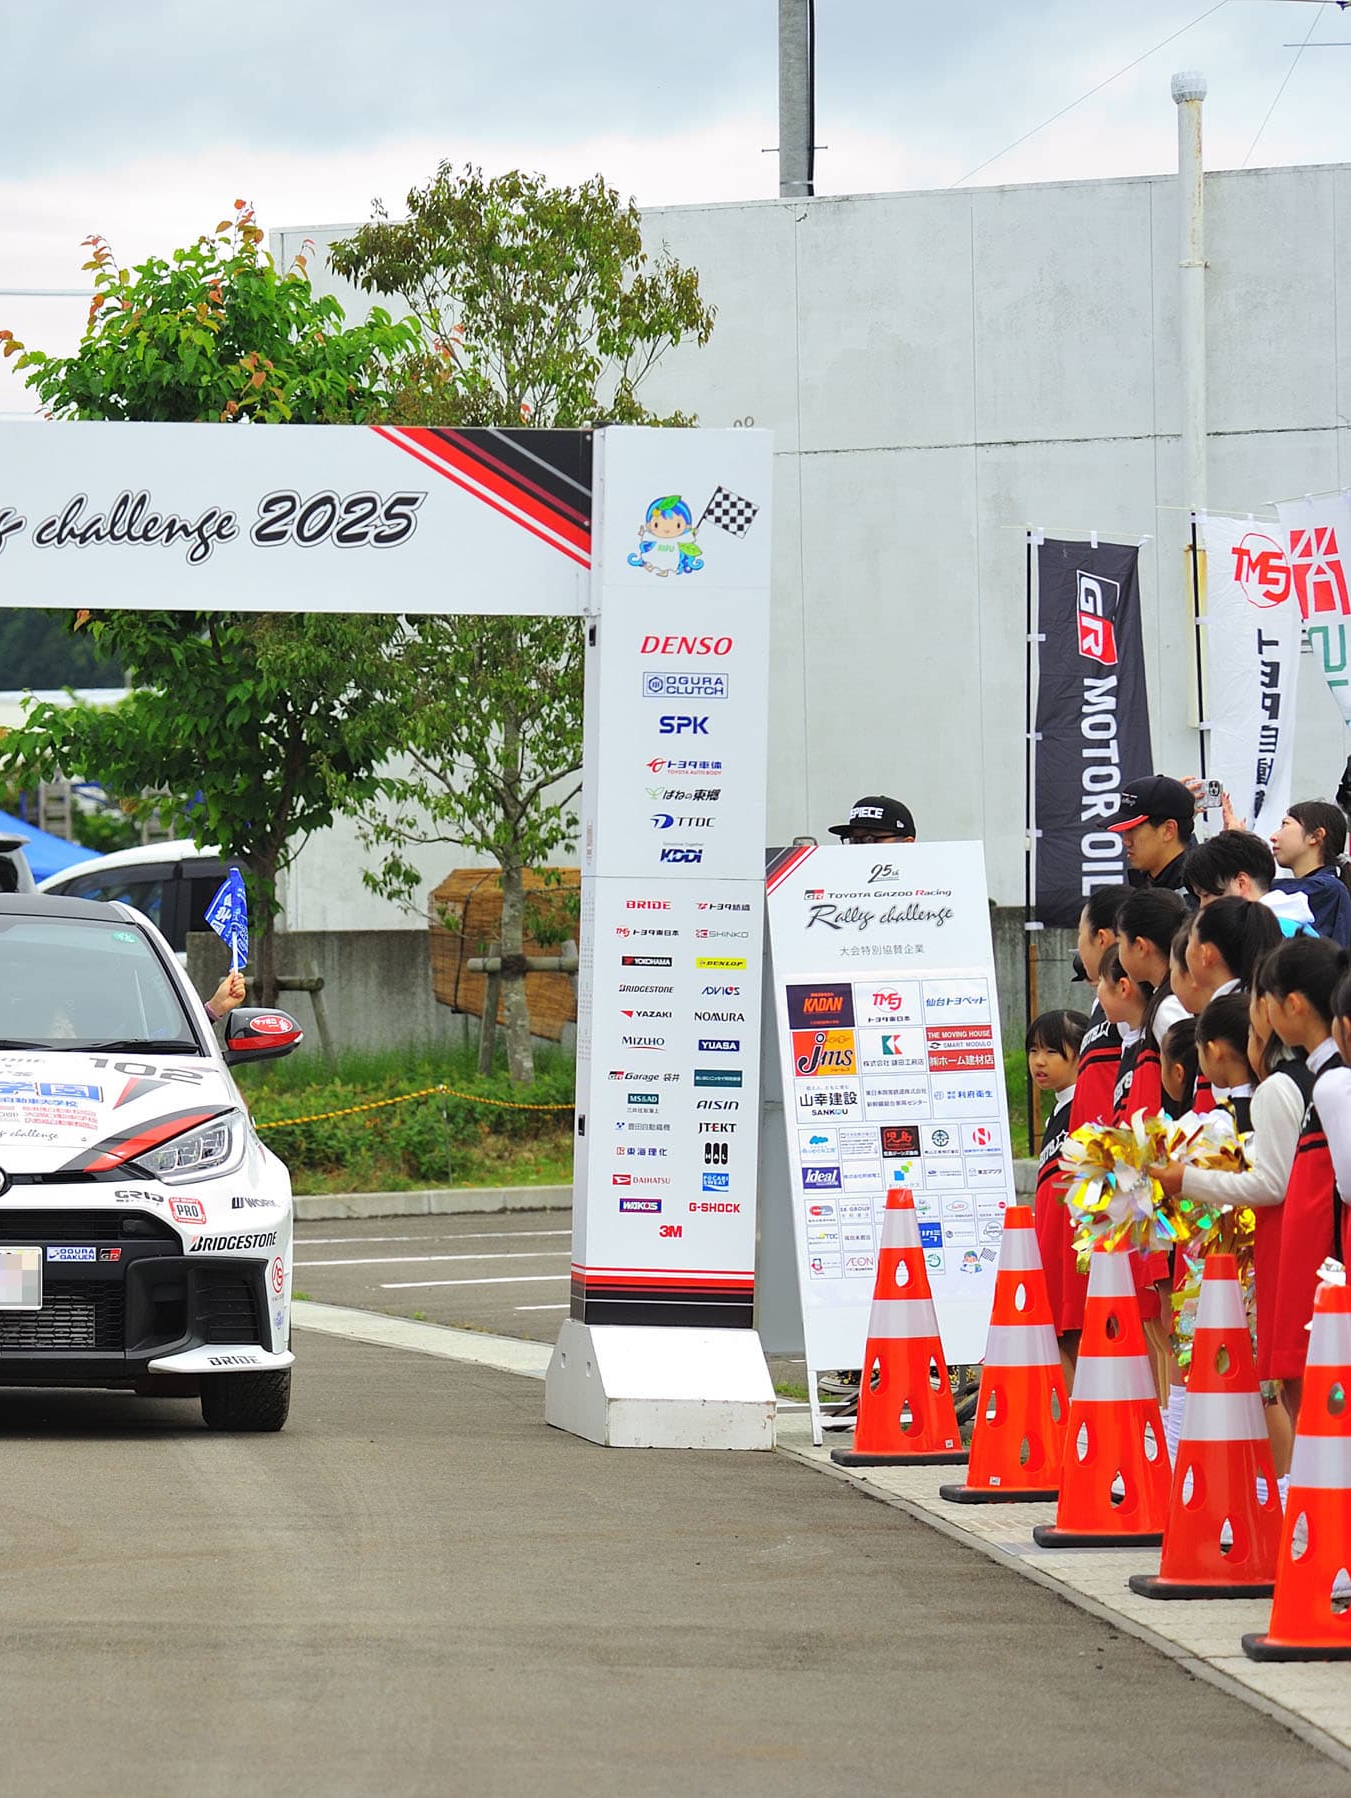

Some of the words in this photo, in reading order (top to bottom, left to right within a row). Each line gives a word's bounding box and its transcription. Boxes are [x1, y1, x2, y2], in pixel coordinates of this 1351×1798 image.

[34, 491, 240, 565] challenge
[252, 491, 427, 548] 2025
[1078, 574, 1115, 662] GR
[641, 636, 733, 656] DENSO
[667, 677, 723, 685] OGURA
[666, 686, 723, 695] CLUTCH
[659, 716, 709, 734] SPK
[1080, 675, 1121, 821] MOTOR
[668, 761, 722, 769] トヨタ車体
[660, 849, 703, 863] KDDI
[1080, 832, 1124, 897] OIL
[874, 890, 912, 898] GAZOO
[915, 889, 951, 898] Racing
[626, 901, 672, 910] BRIDE
[806, 904, 874, 930] Rally
[880, 904, 954, 926] challenge
[619, 985, 674, 993] BRIDGESTONE
[803, 997, 843, 1013] KADAN
[926, 997, 986, 1007] 仙台トヨペット
[694, 1012, 744, 1022] NOMURA
[622, 1036, 665, 1045] MIZUHO
[798, 1033, 853, 1073] jms
[863, 1059, 889, 1067] 株式会社
[89, 1057, 205, 1086] 102
[625, 1073, 659, 1082] Garage
[696, 1101, 739, 1110] AISIN
[800, 1092, 857, 1107] 山幸建設
[698, 1123, 736, 1134] JTEKT
[10, 1130, 59, 1141] challenge
[806, 1169, 837, 1183] Ideal
[176, 1204, 199, 1218] PRO
[689, 1203, 740, 1213] G-SHOCK
[659, 1225, 682, 1238] 3M
[189, 1231, 278, 1252] BRIDGESTONE
[209, 1356, 262, 1366] BRIDE
